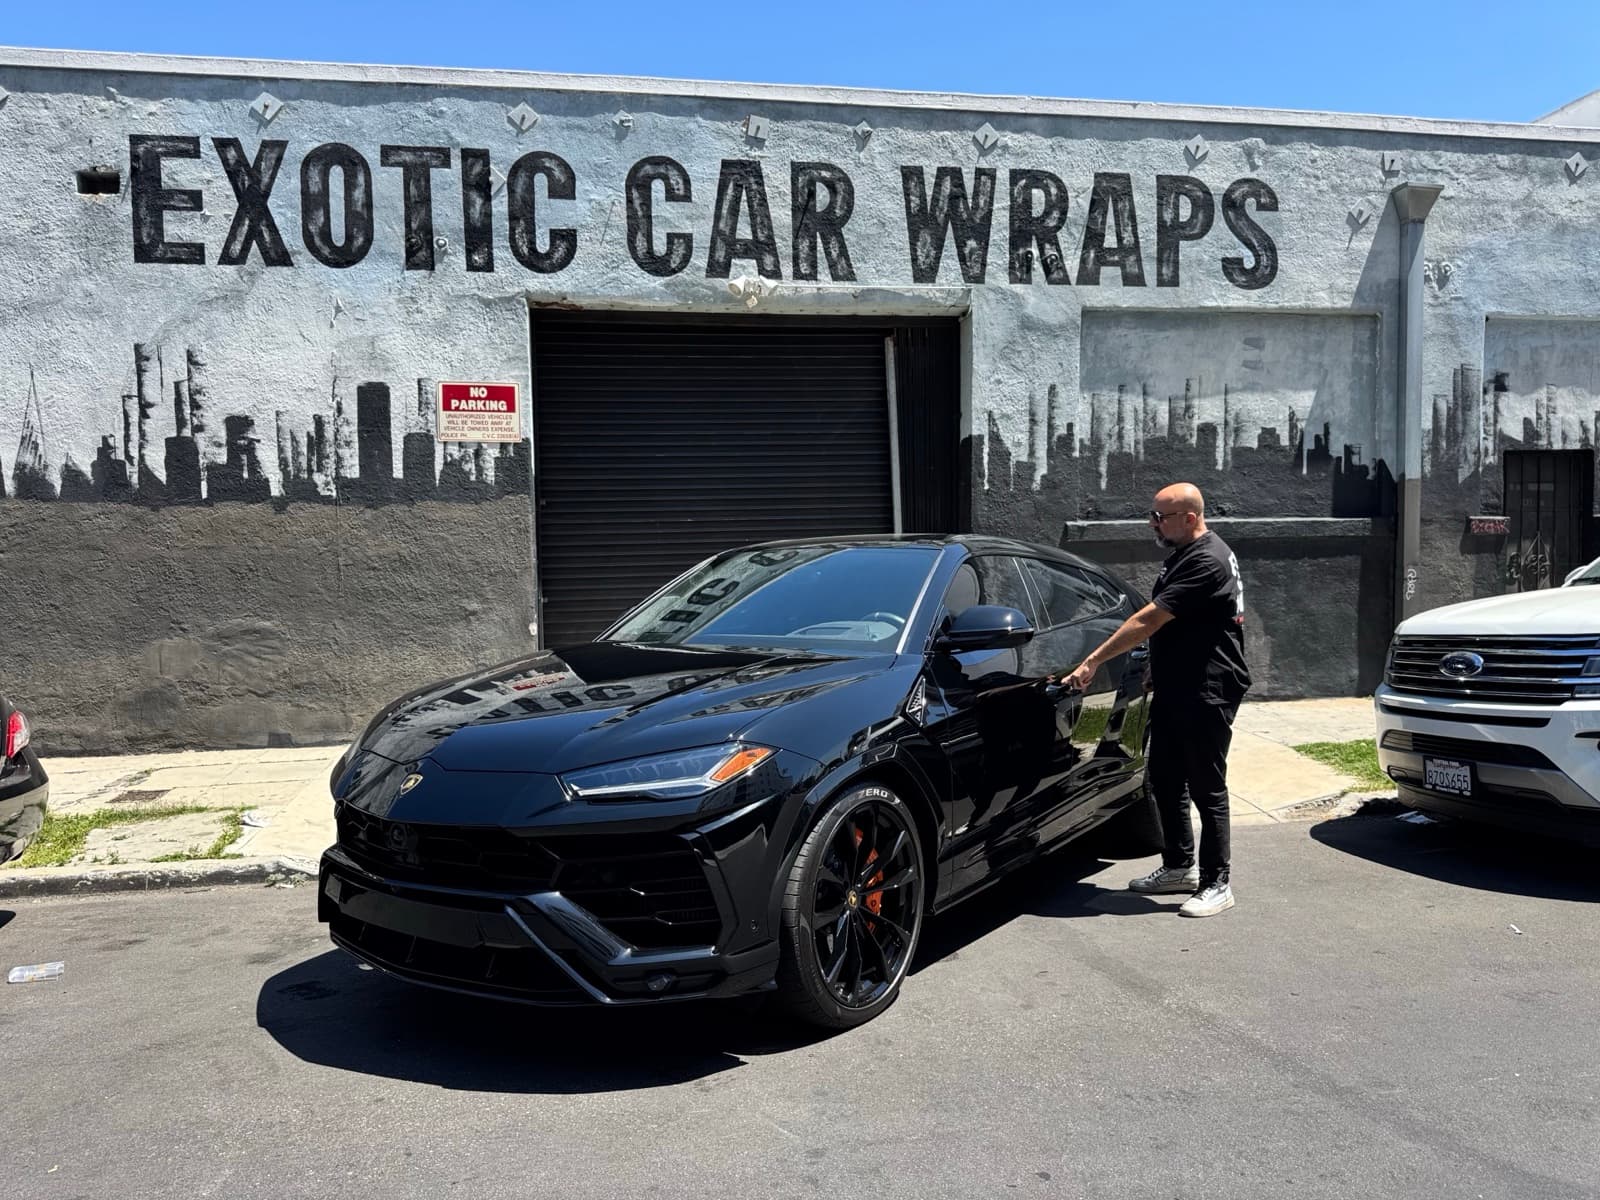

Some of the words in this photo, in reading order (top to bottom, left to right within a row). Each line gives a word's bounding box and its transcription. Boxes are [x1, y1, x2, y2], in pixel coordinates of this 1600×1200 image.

[129, 134, 578, 273] EXOTIC
[624, 155, 857, 282] CAR
[900, 164, 1280, 291] WRAPS
[469, 386, 488, 398] NO
[450, 399, 508, 411] PARKING
